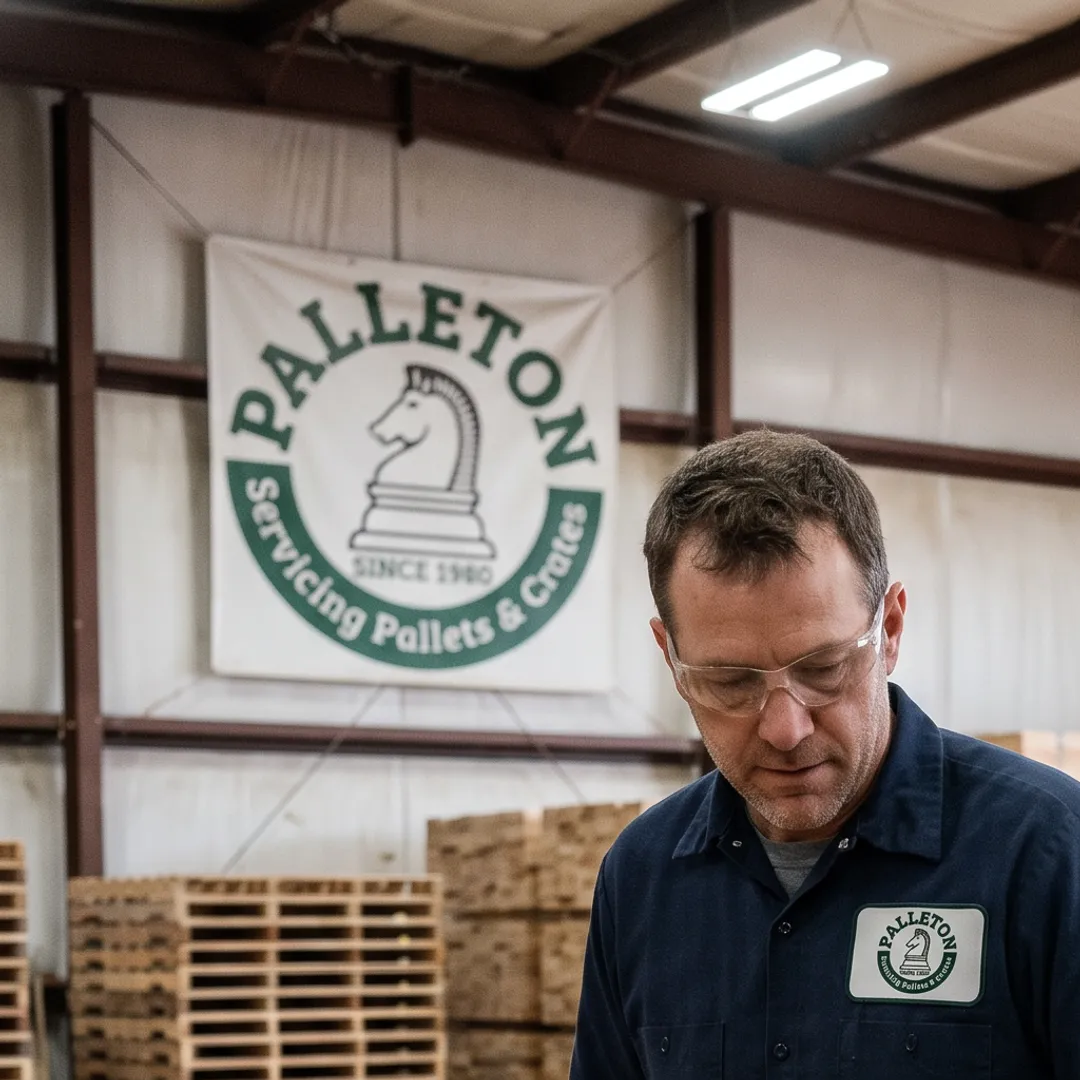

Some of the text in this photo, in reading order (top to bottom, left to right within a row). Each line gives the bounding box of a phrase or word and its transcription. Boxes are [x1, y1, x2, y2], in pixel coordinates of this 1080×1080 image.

[230, 281, 598, 472] PALLETON
[246, 476, 588, 654] Servicing Pallets & Crates
[353, 556, 428, 582] SINCE
[879, 911, 957, 949] PALLETON
